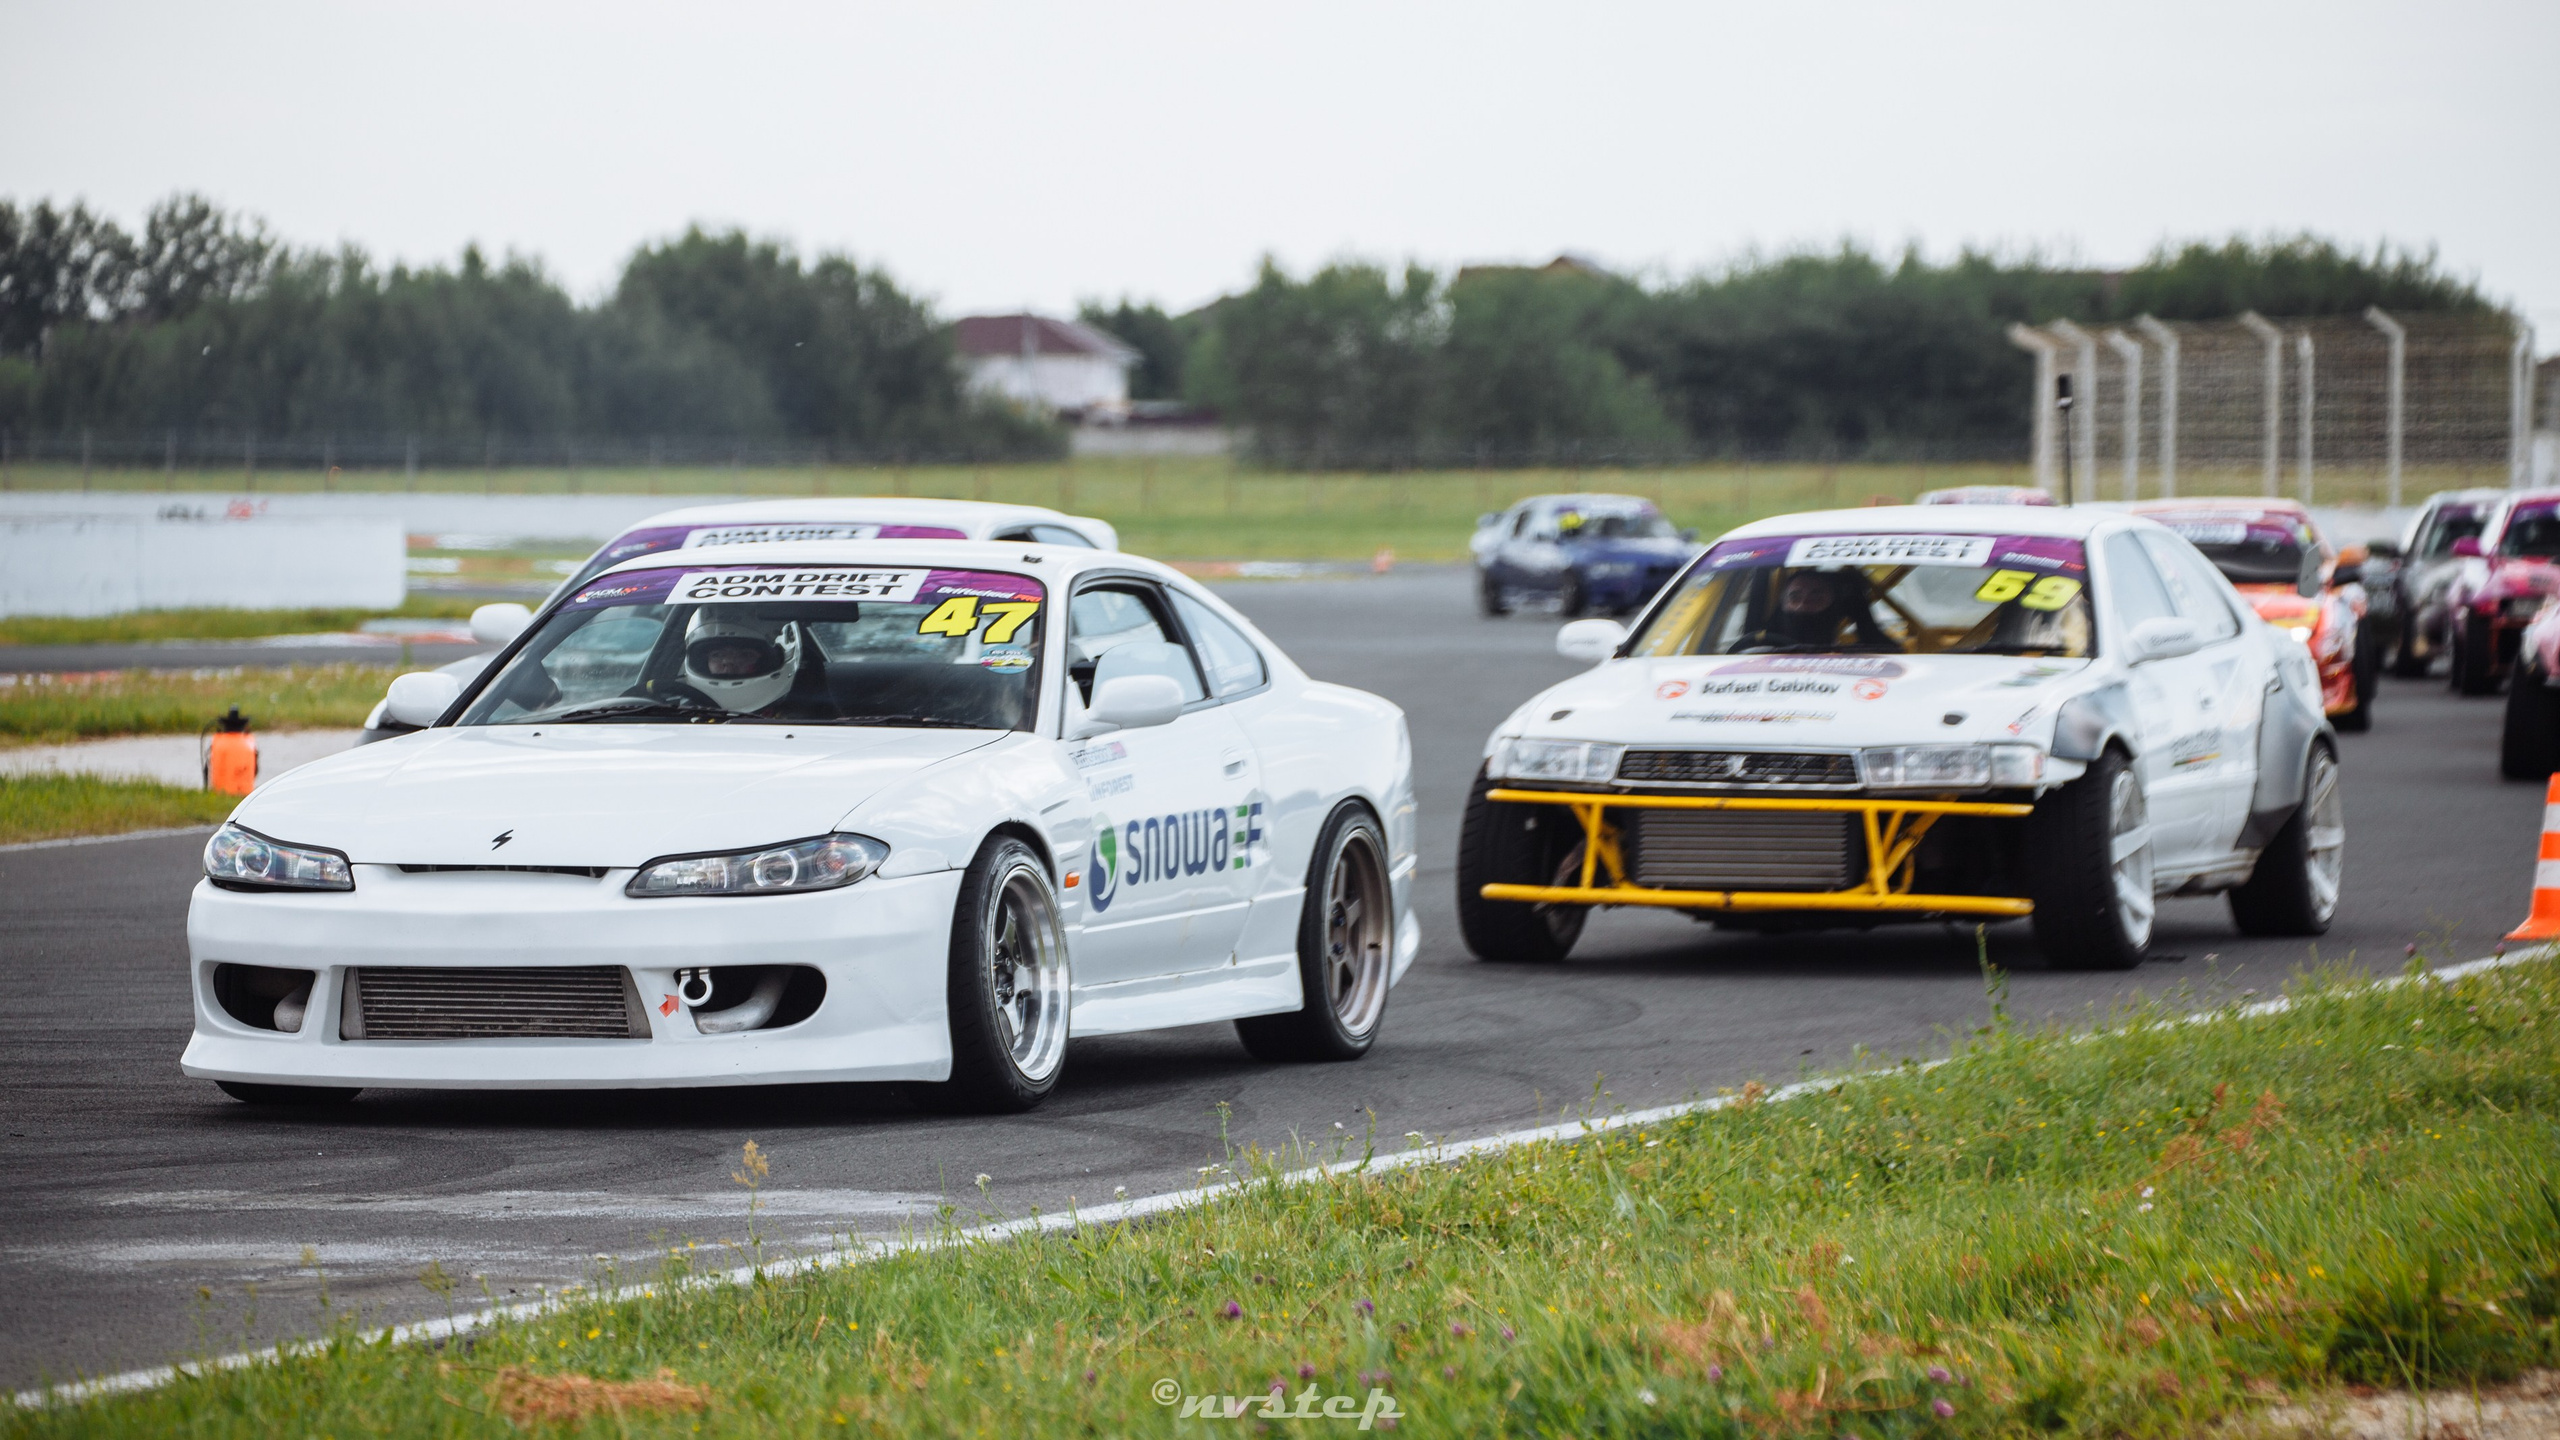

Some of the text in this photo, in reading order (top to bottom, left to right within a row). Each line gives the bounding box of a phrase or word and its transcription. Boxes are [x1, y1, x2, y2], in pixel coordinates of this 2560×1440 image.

[1805, 547, 1973, 558] CONTEST
[694, 572, 910, 586] ADM DRIFT
[686, 584, 903, 600] CONTEST
[918, 595, 1040, 644] 47
